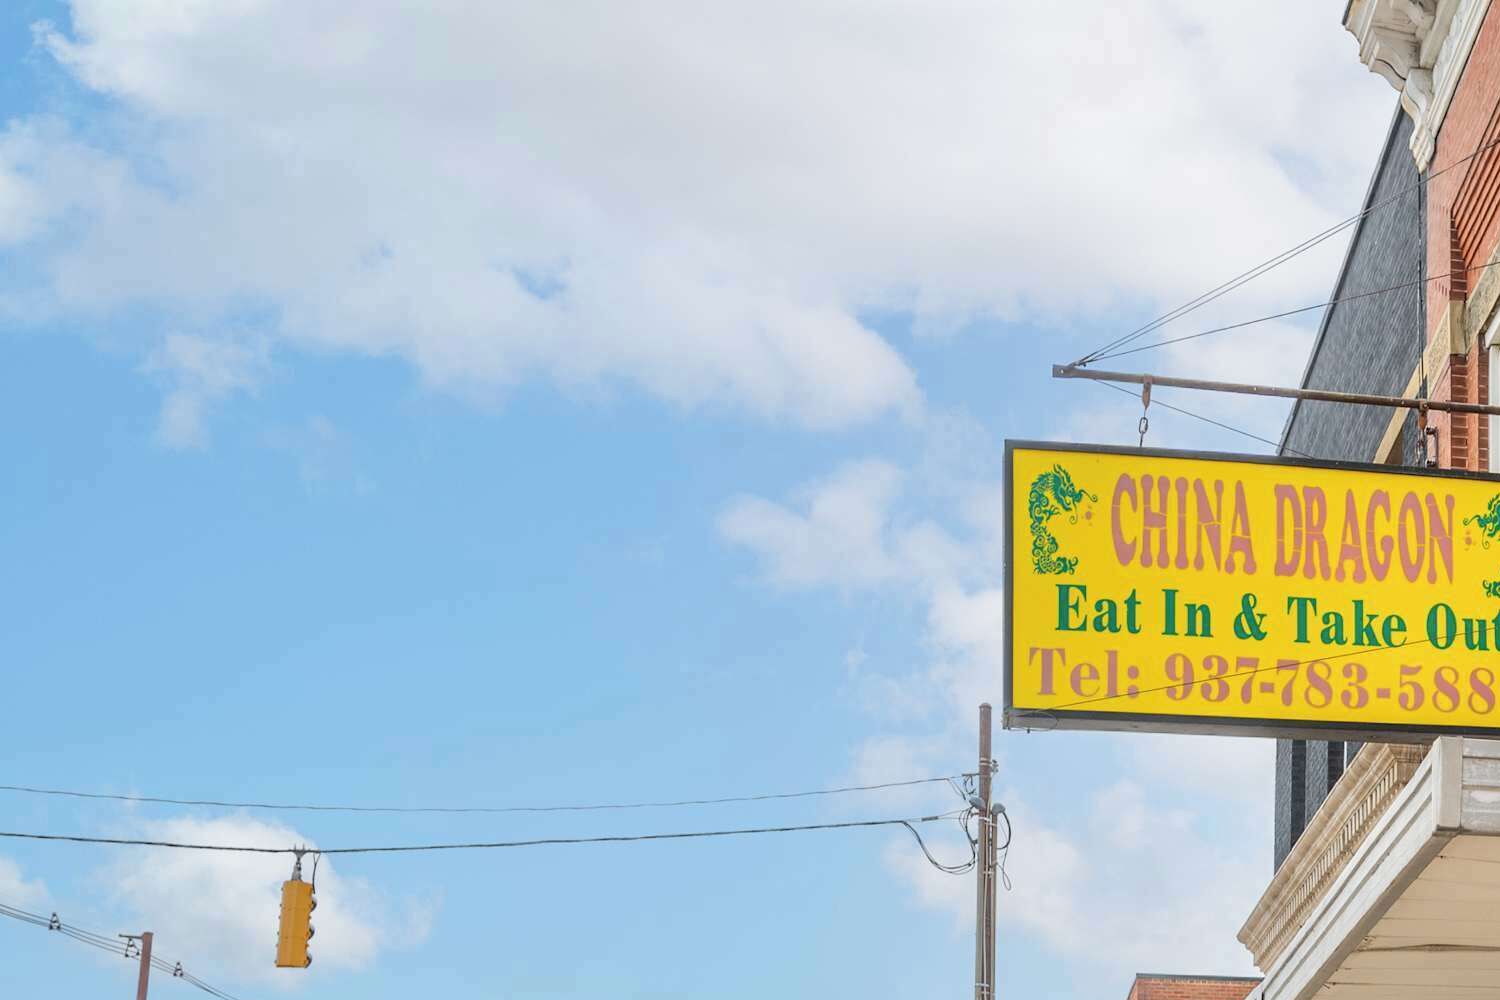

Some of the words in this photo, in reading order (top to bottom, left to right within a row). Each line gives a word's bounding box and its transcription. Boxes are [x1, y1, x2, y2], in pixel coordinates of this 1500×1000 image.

[1111, 473, 1257, 576] CHINA
[1273, 484, 1456, 585] DRAGON
[1054, 583, 1142, 636] Eat
[1161, 588, 1213, 639] In
[1233, 592, 1268, 641] &
[1287, 596, 1407, 649] Take
[1028, 646, 1141, 699] Tel:
